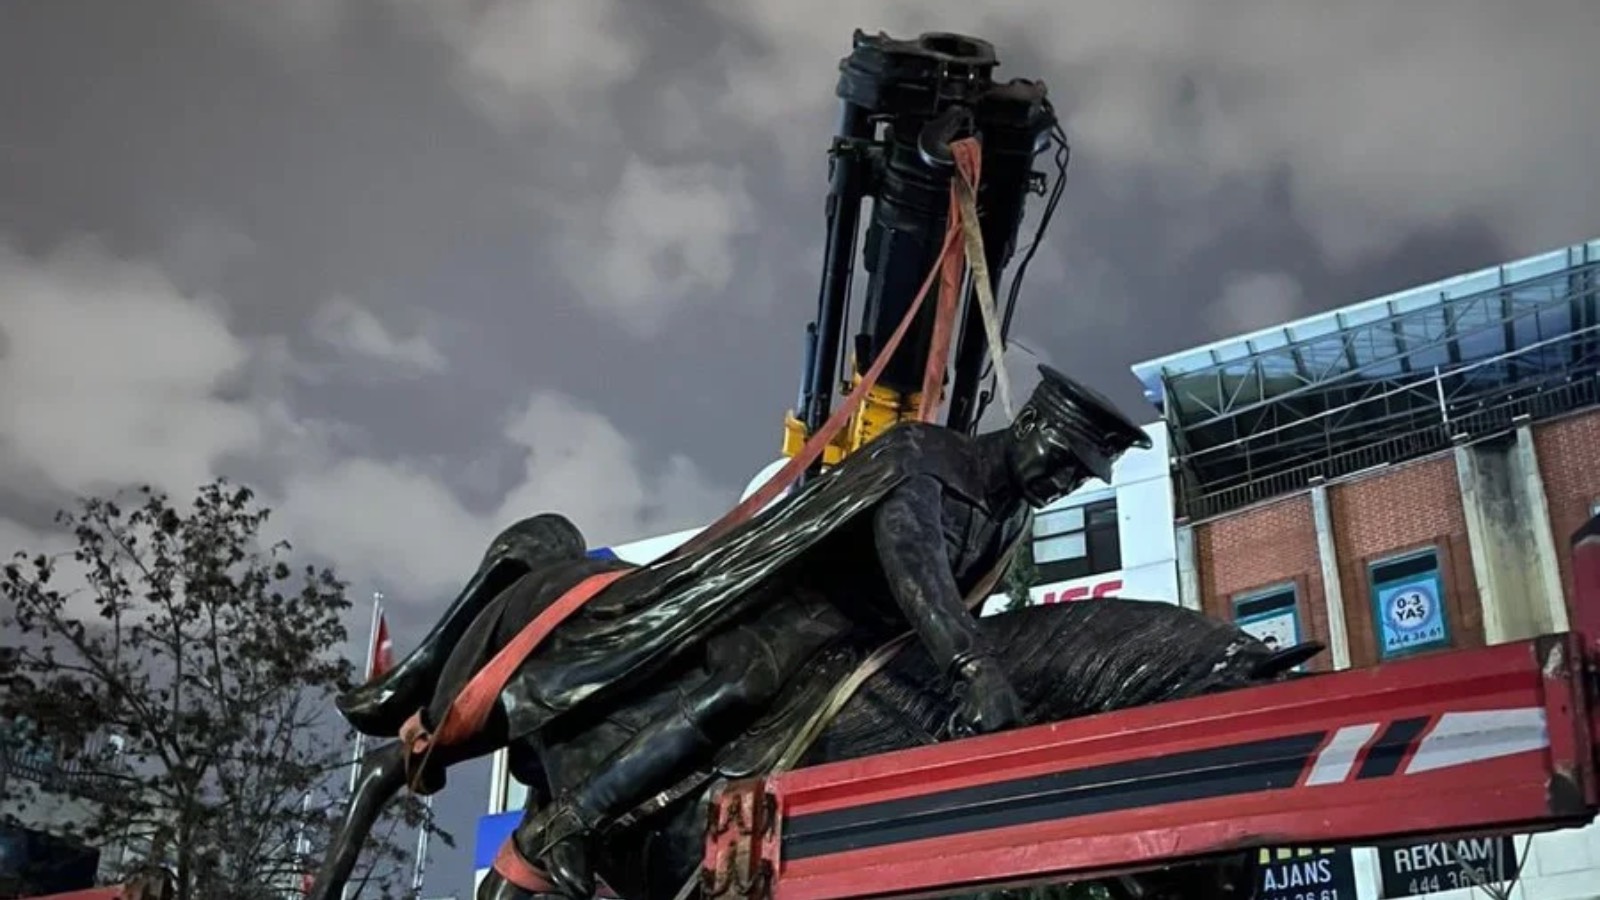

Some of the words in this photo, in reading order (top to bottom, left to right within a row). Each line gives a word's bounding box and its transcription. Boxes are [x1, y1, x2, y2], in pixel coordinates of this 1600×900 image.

[1397, 594, 1421, 609] 0-3
[1395, 605, 1425, 621] YAŞ
[1394, 837, 1494, 873] REKLAM
[1264, 858, 1332, 892] AJANS
[1409, 874, 1440, 894] 444
